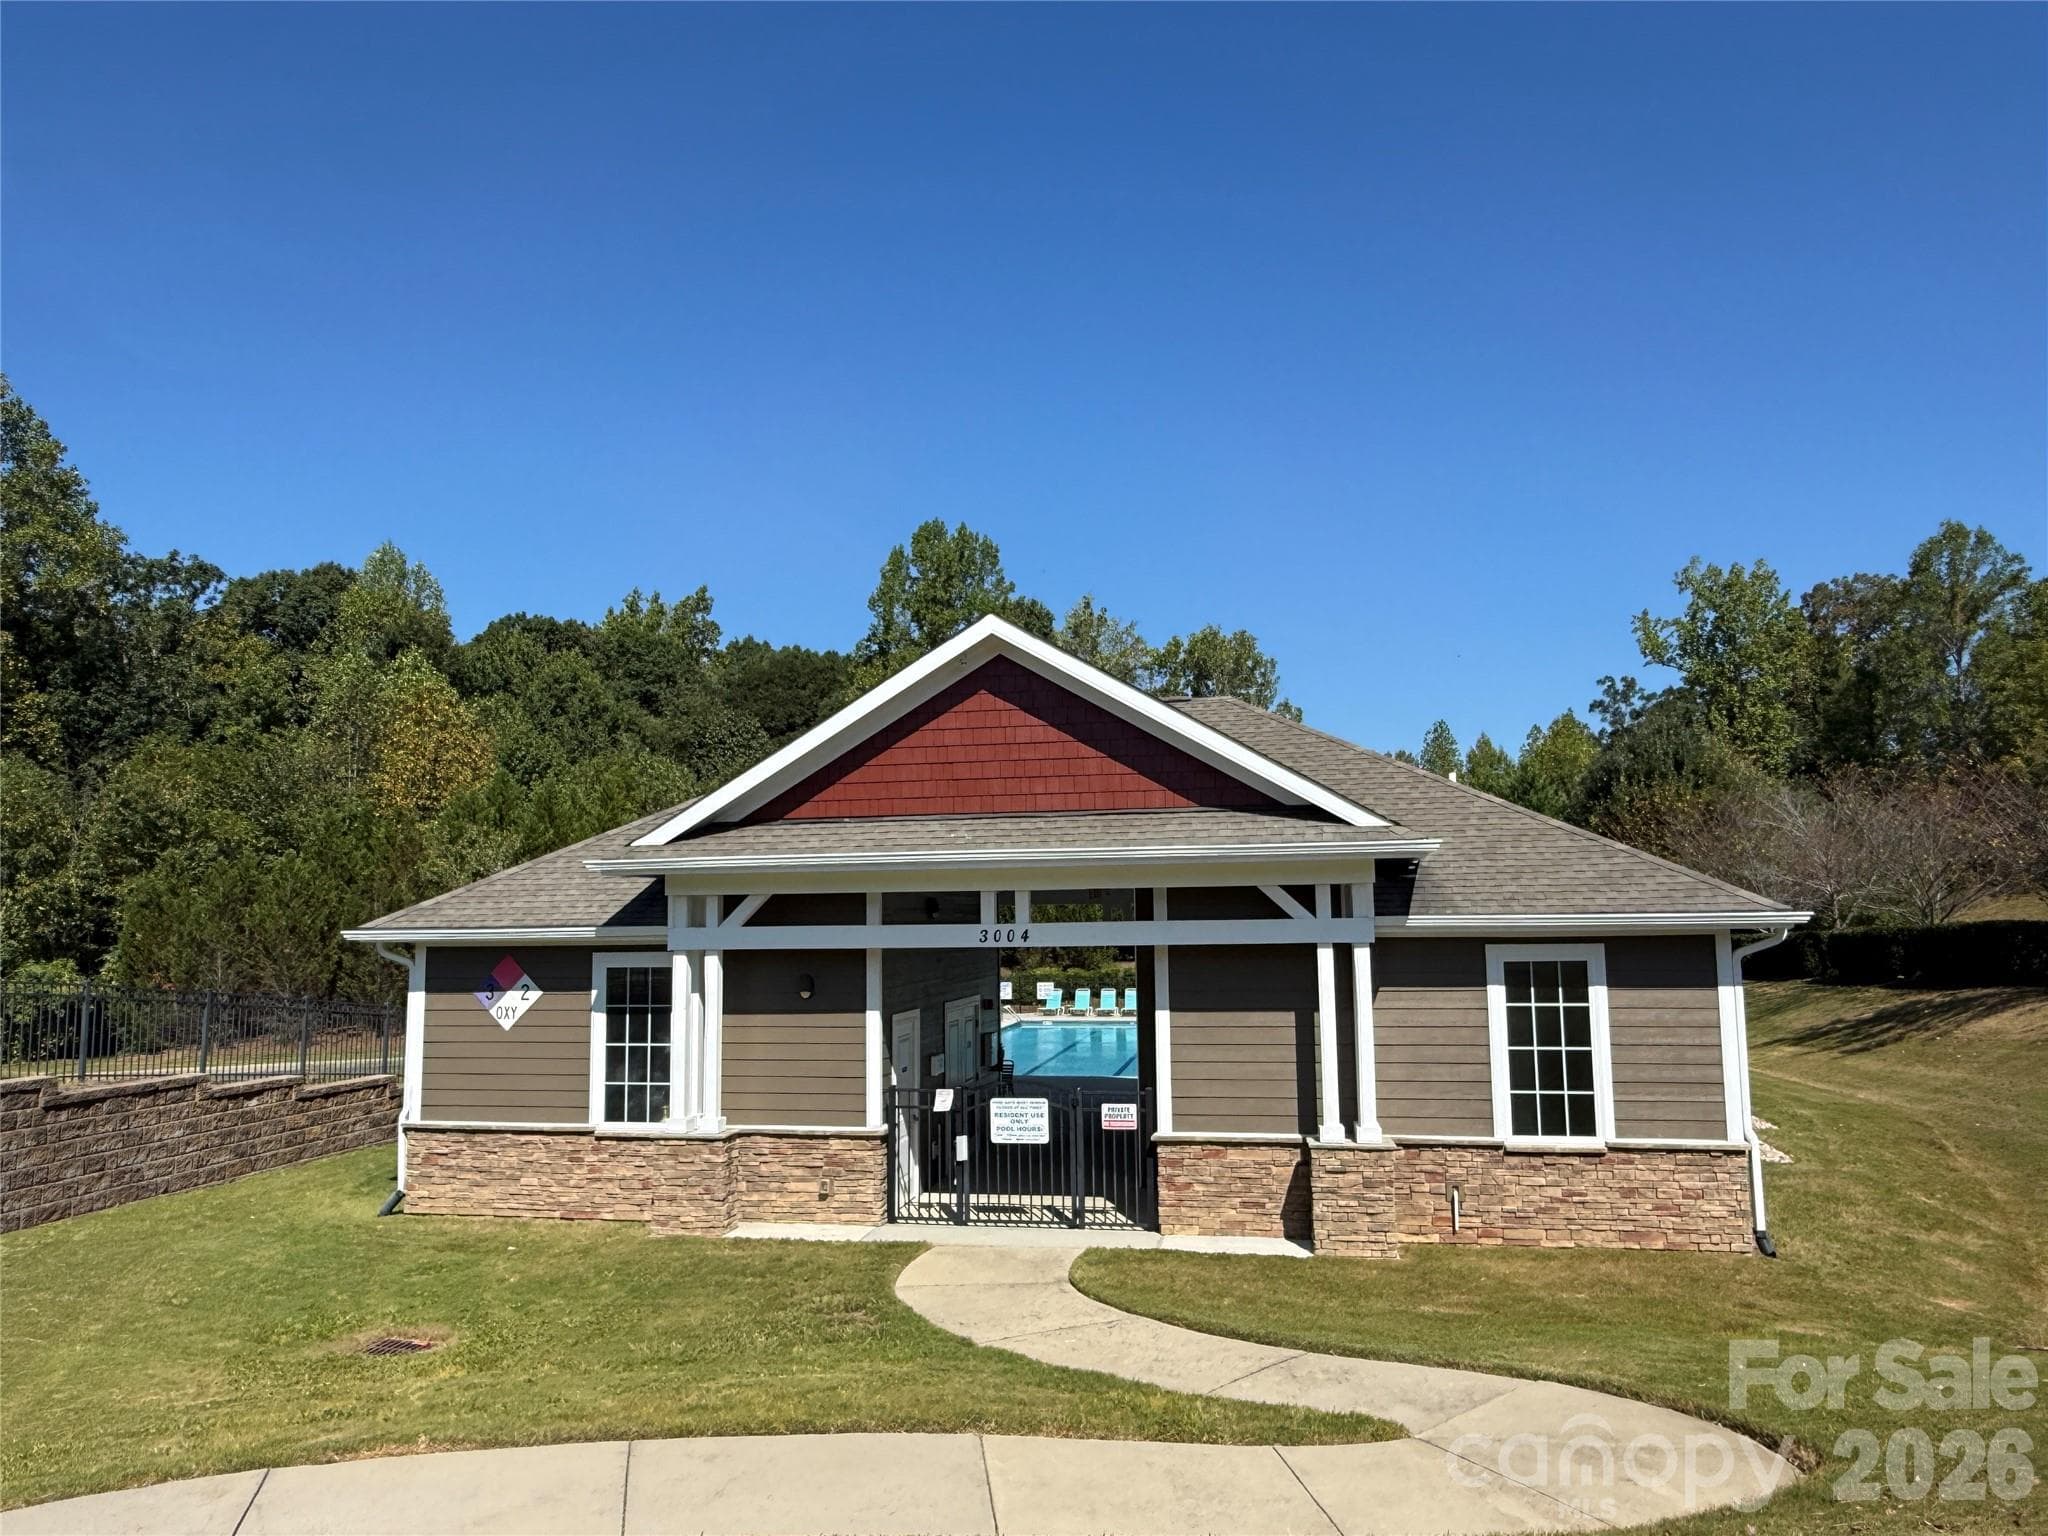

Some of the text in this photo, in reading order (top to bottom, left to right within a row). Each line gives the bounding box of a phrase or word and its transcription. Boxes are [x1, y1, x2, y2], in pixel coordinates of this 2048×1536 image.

[979, 929, 1030, 943] 3004
[485, 983, 495, 1001] 3
[520, 983, 531, 1001] 2
[496, 1006, 518, 1020] OXY
